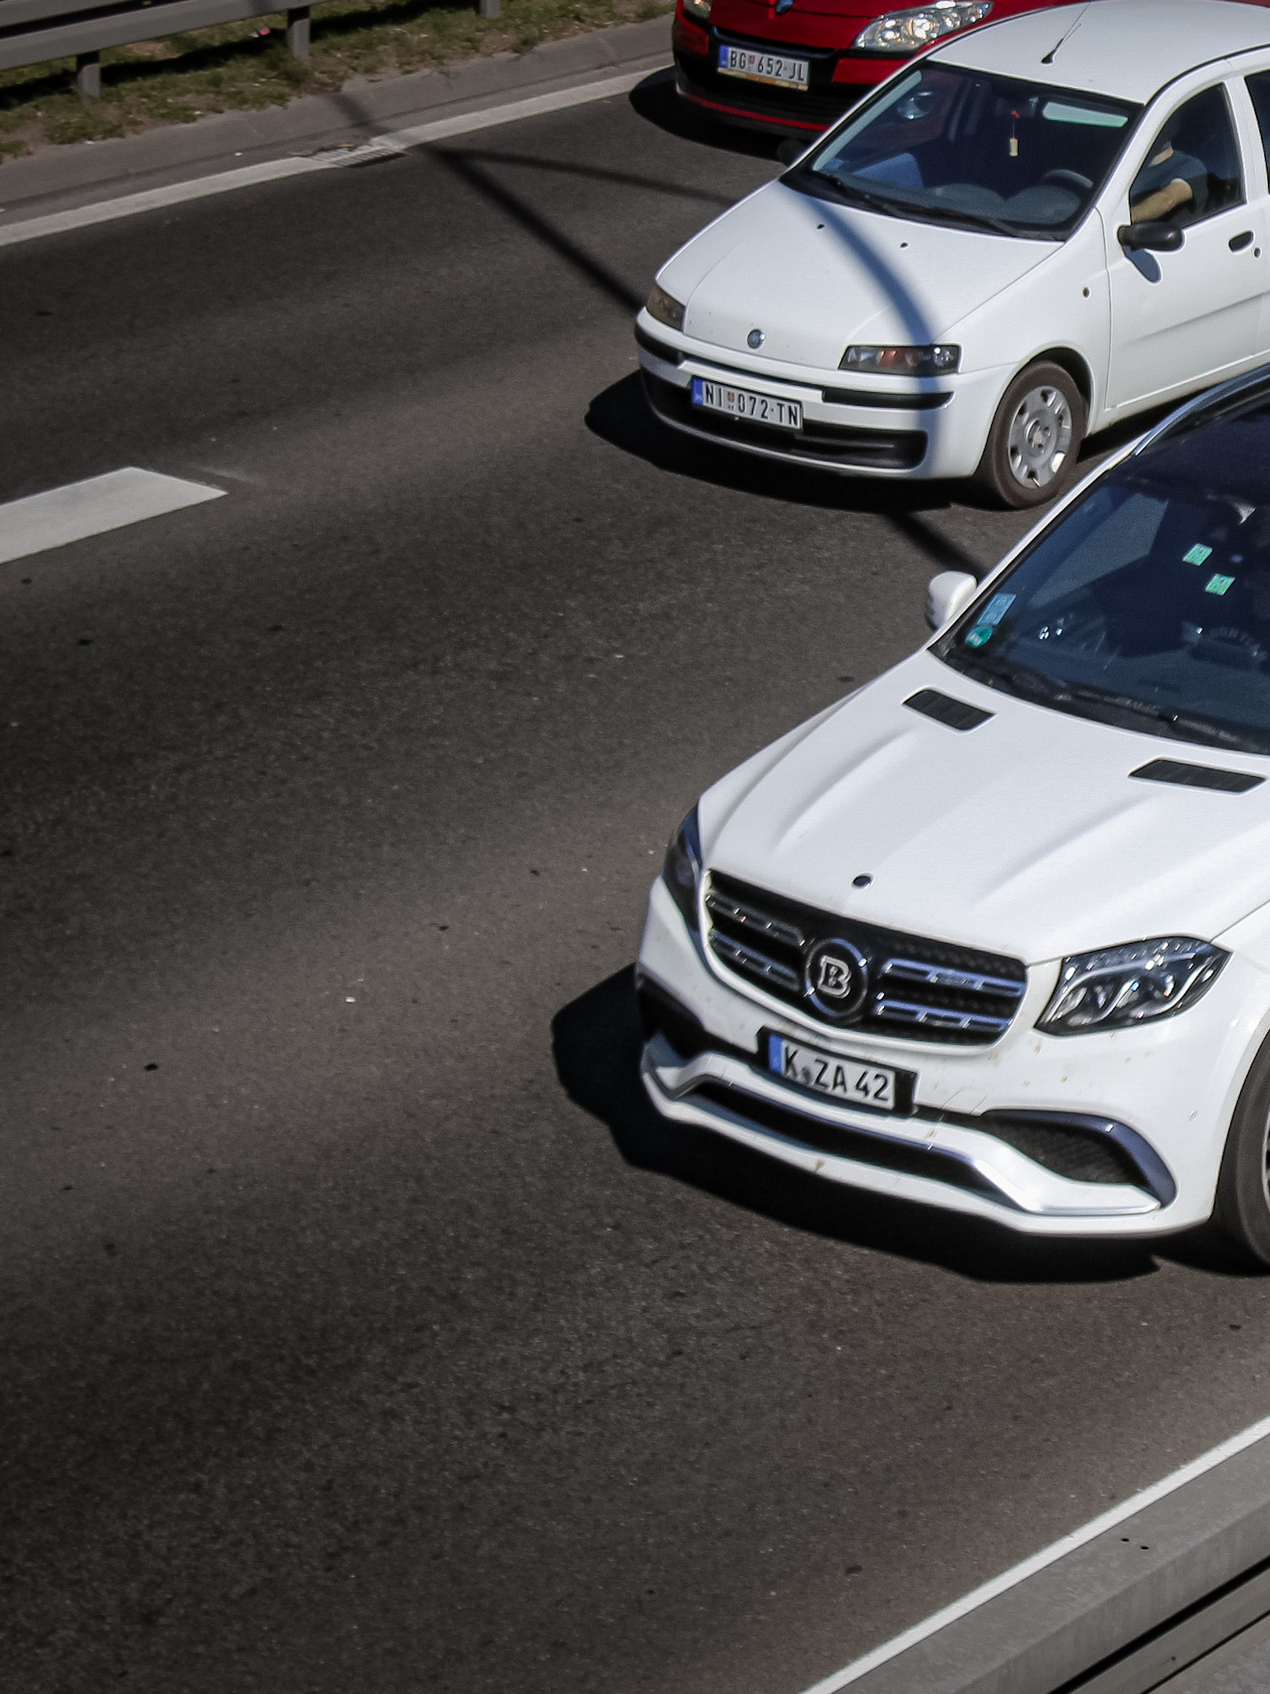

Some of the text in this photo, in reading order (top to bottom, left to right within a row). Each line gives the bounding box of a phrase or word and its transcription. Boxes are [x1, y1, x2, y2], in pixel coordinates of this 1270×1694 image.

[730, 50, 746, 69] BG
[705, 384, 722, 407] NI
[784, 1046, 889, 1101] K ZA 42
